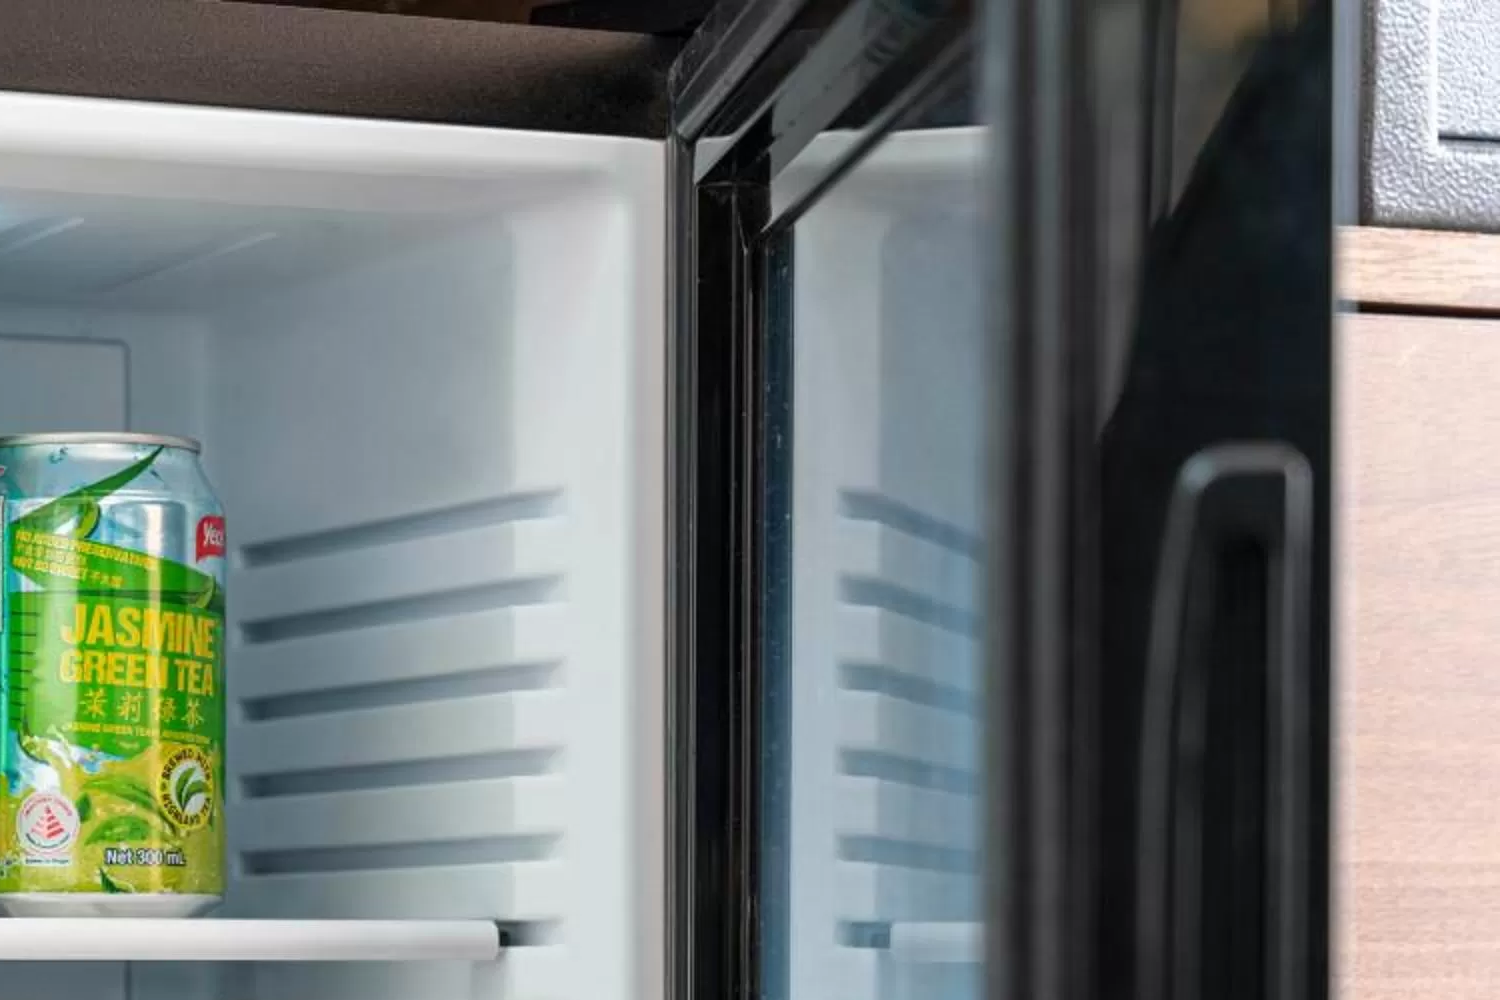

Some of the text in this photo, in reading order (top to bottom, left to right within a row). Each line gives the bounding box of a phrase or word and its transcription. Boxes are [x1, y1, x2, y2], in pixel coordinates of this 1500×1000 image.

[60, 602, 216, 660] JASMINE
[59, 648, 214, 697] GREEN TEA
[161, 747, 194, 780] BREWED
[106, 849, 133, 865] Net
[135, 850, 164, 865] 300
